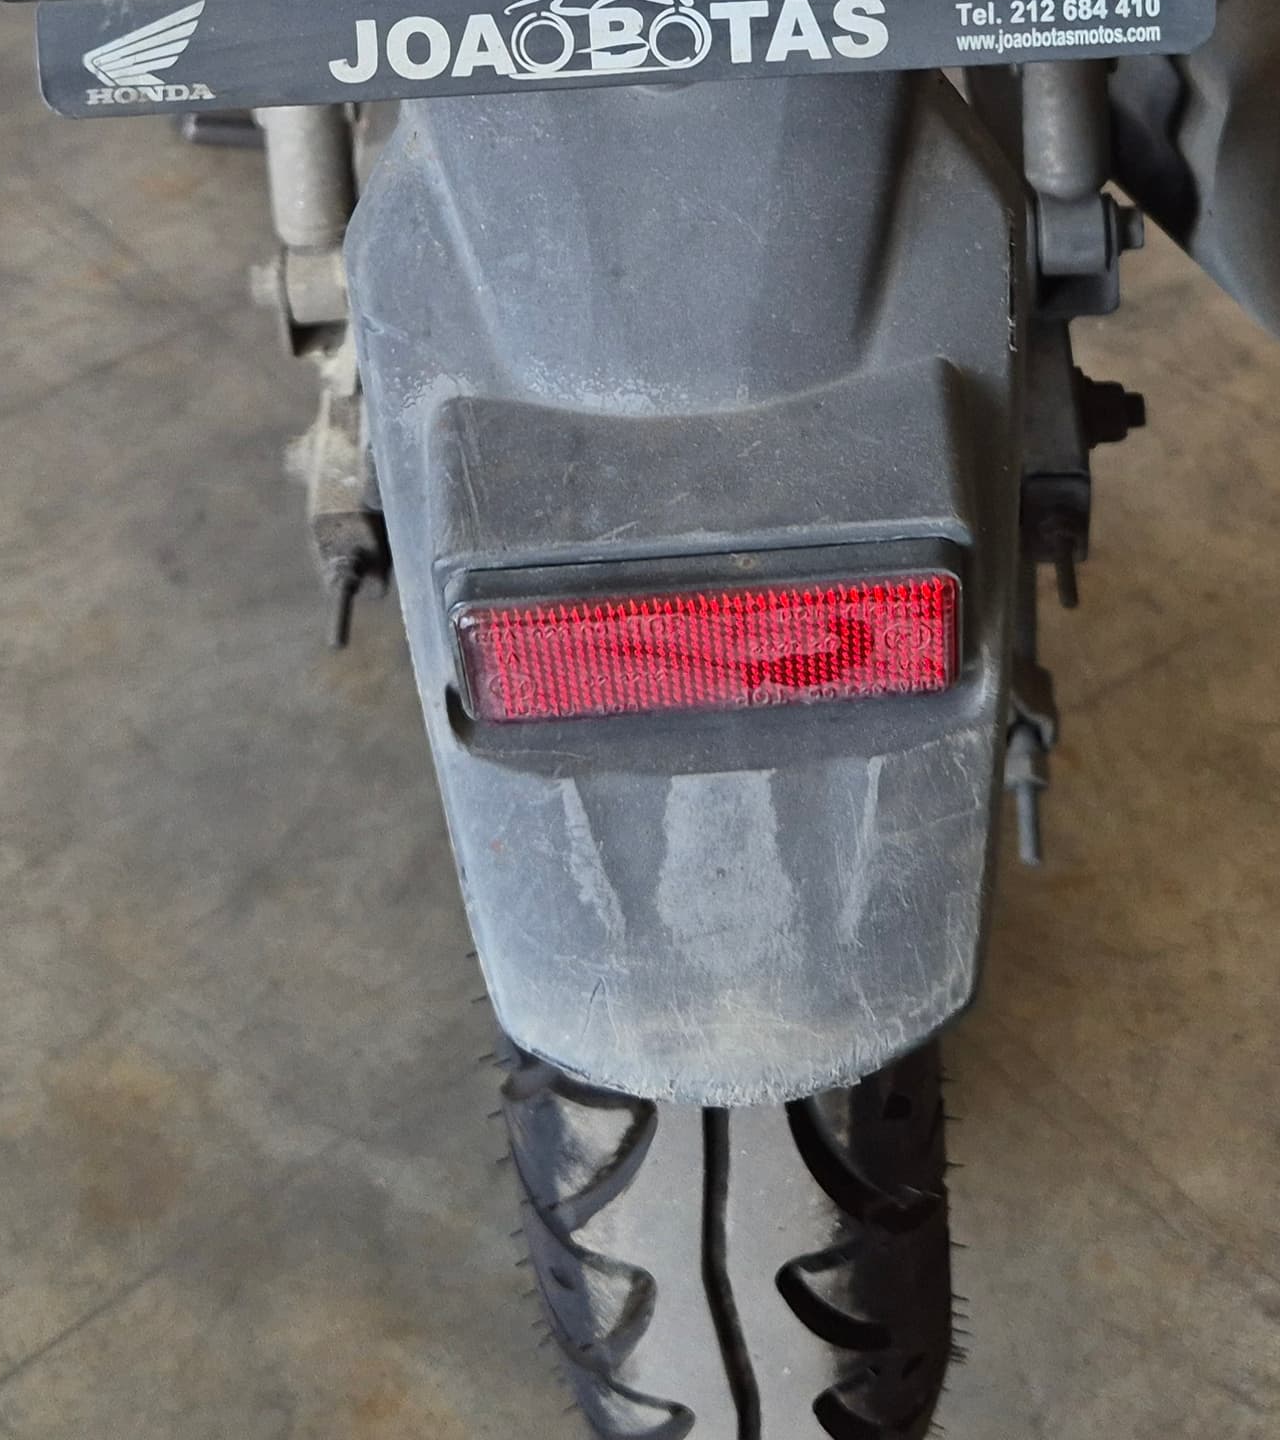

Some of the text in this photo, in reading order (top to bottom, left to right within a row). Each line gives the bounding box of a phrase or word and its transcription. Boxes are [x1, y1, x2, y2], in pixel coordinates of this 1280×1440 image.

[955, 1, 1003, 27] Tel.
[956, 25, 1161, 54] www.joaobotasmotos.com
[85, 82, 217, 106] HONDA
